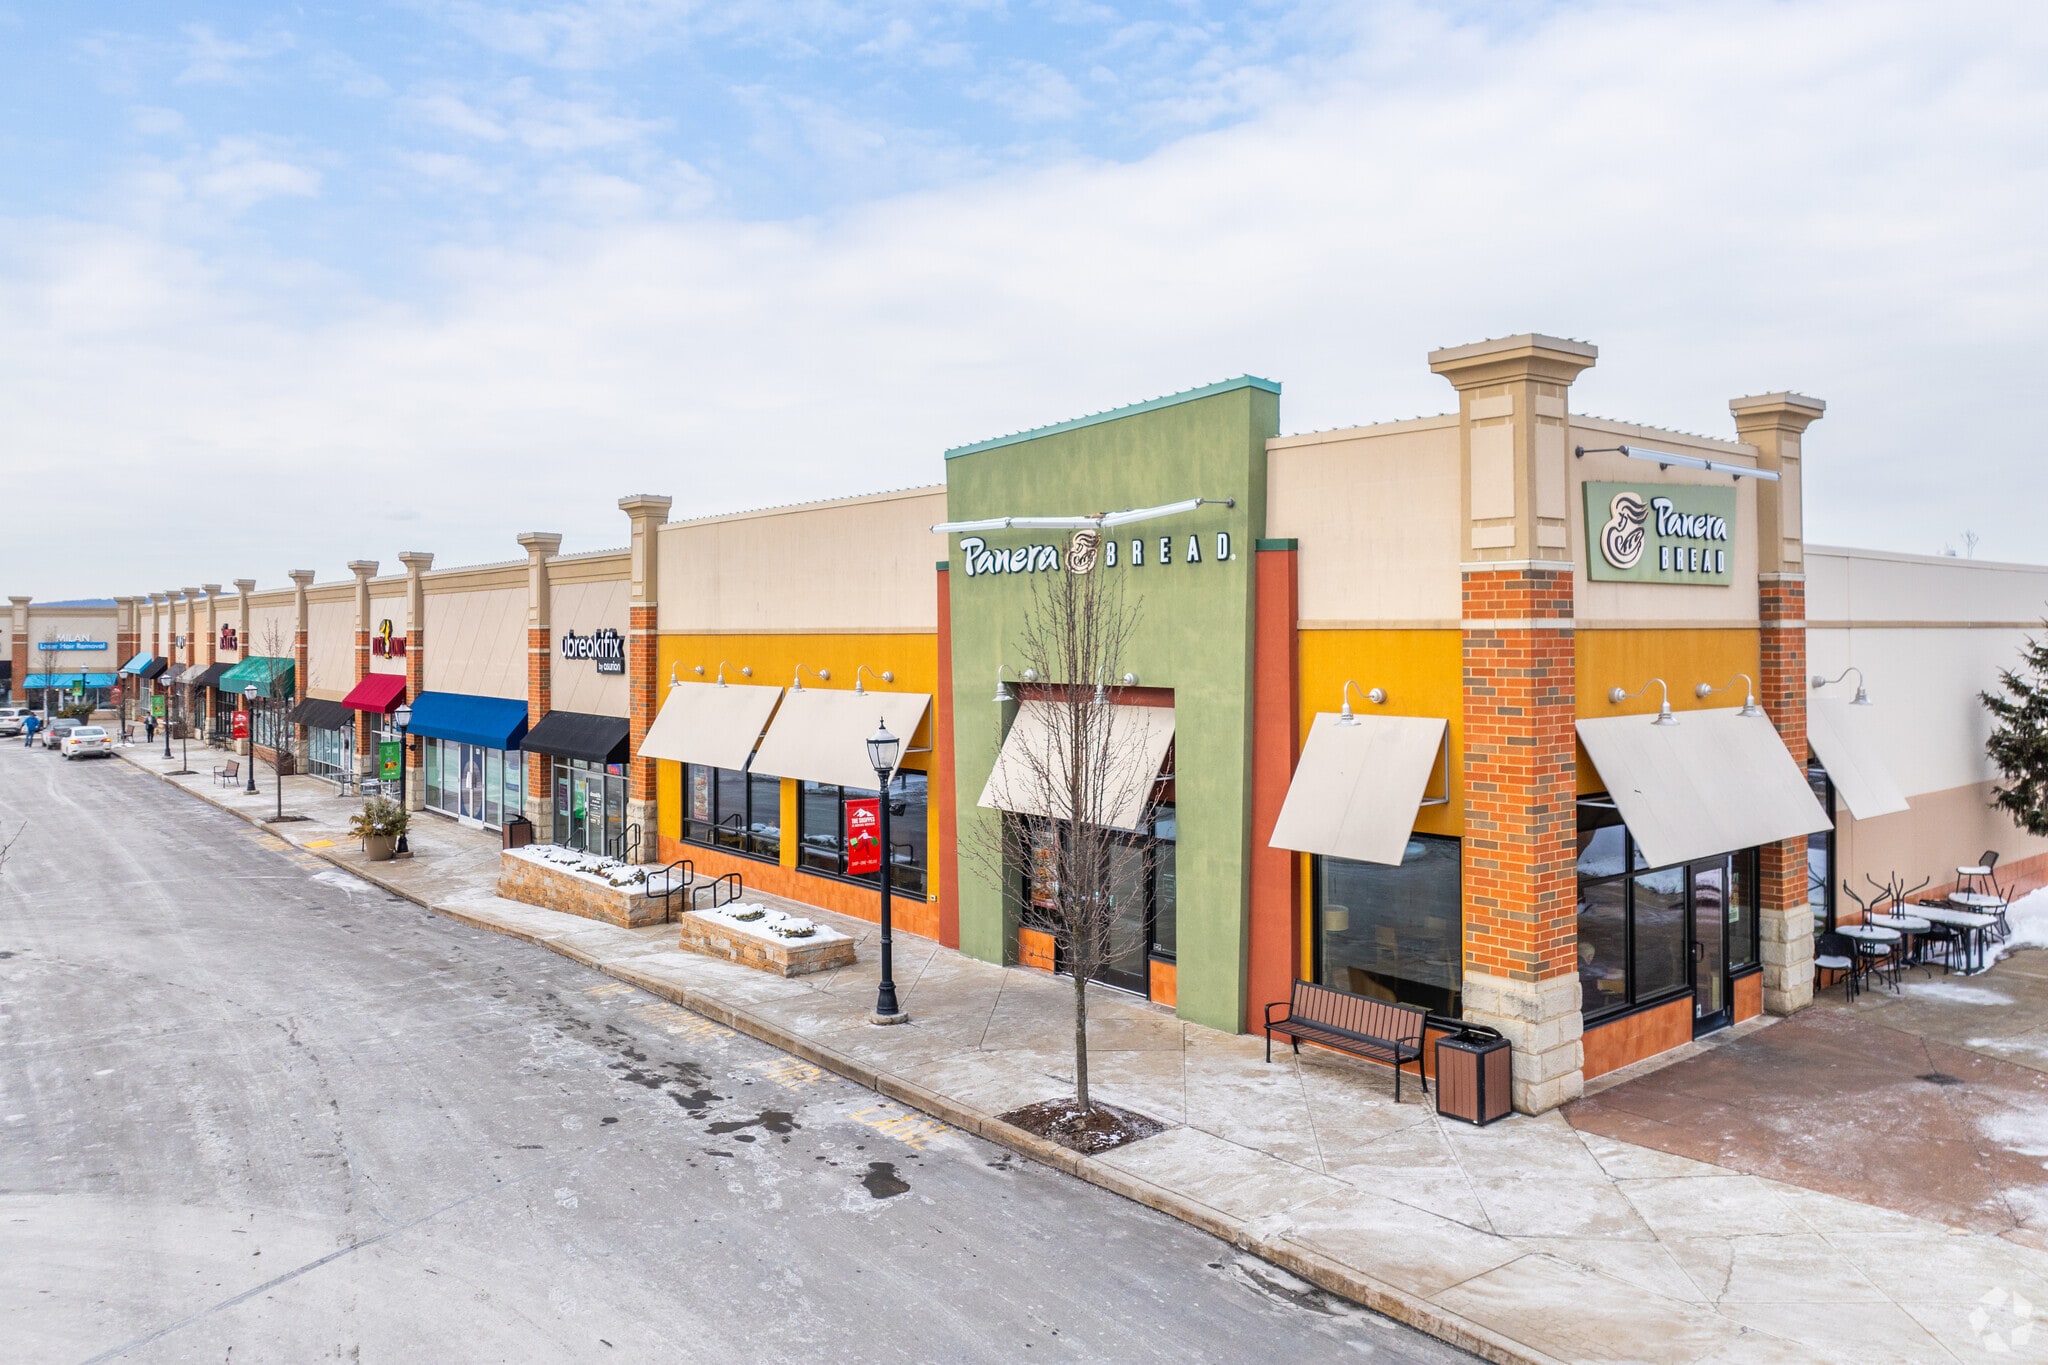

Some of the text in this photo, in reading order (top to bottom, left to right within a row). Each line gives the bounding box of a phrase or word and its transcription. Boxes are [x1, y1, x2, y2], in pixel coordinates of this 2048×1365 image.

[1651, 496, 1727, 541] Panera
[960, 532, 1231, 576] Panera BREAD
[1659, 545, 1725, 573] BREAD
[56, 633, 91, 642] MILAN
[77, 643, 106, 651] Removal
[561, 630, 622, 658] ubreakifix
[604, 661, 621, 672] asurion
